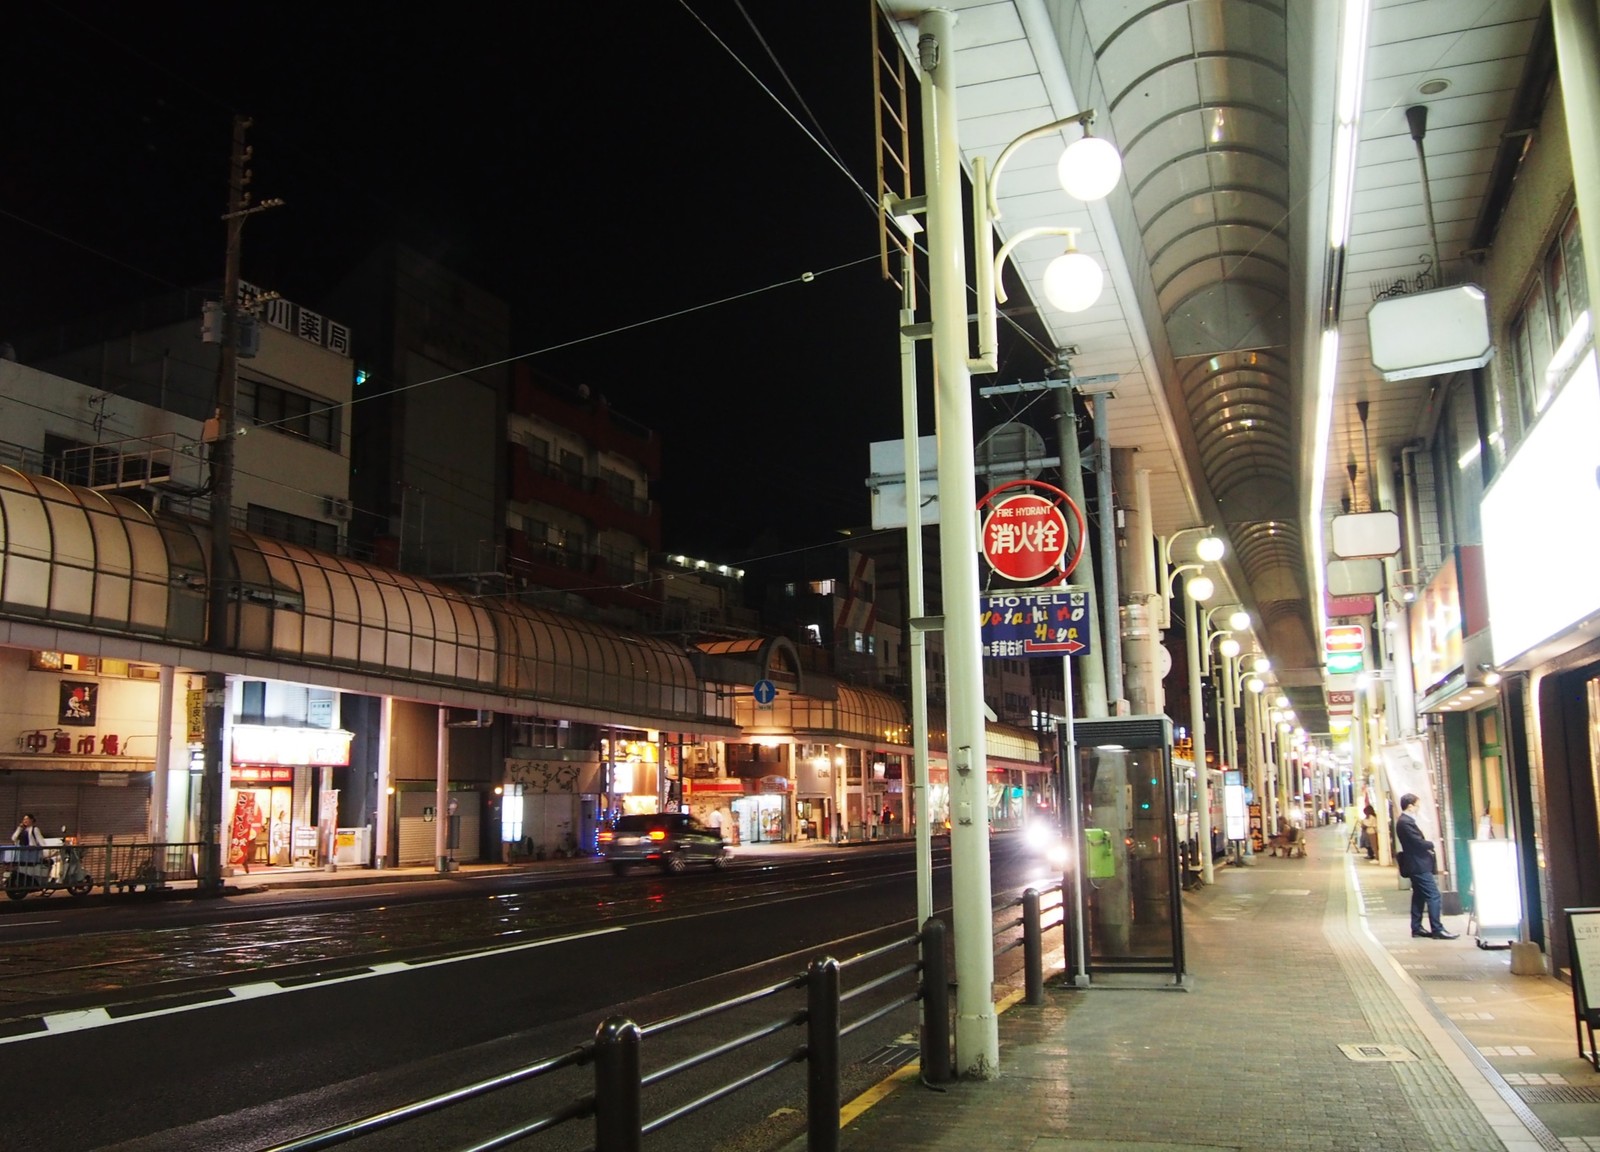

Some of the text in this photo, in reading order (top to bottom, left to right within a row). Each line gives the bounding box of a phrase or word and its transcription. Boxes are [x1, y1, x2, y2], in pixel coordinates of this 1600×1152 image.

[996, 505, 1051, 518] FIRE HYDRANT
[990, 519, 1060, 555] 消火栓
[988, 594, 1067, 608] HOTEL
[1034, 623, 1079, 643] Heya
